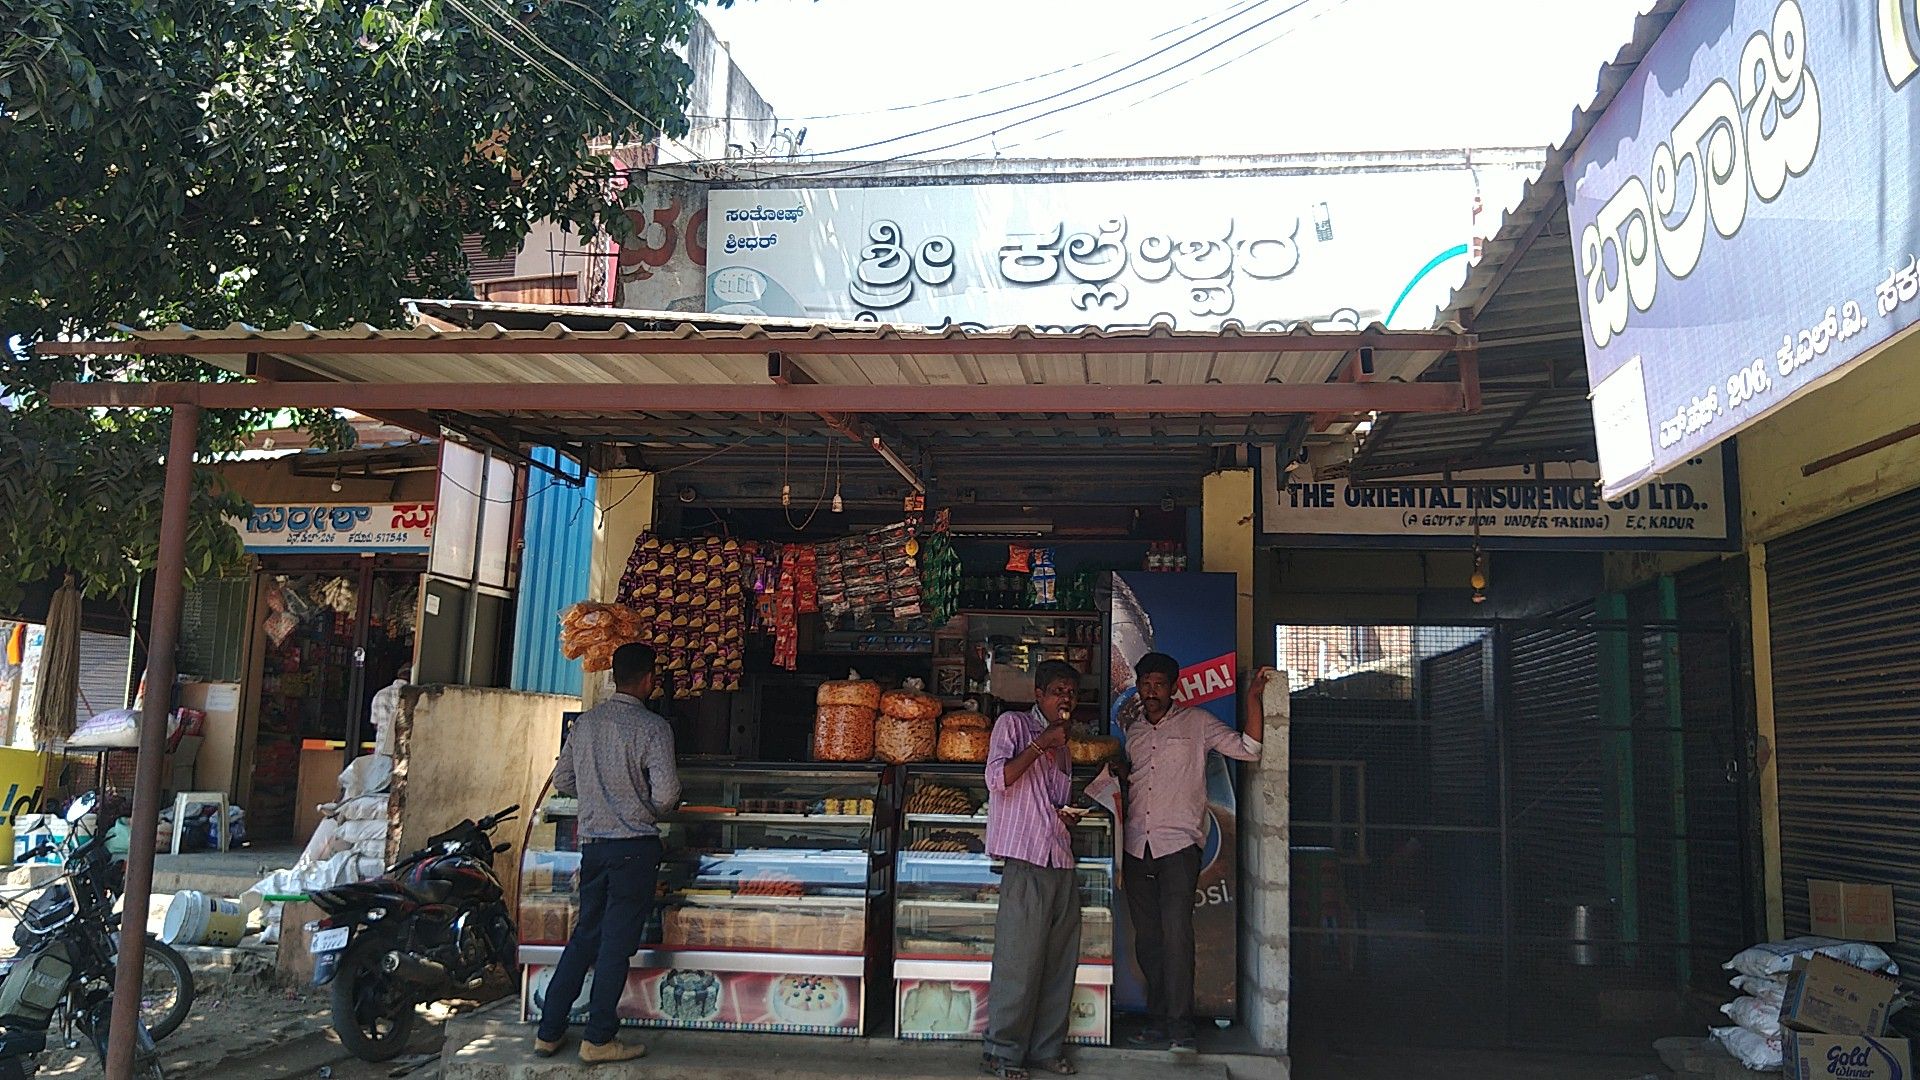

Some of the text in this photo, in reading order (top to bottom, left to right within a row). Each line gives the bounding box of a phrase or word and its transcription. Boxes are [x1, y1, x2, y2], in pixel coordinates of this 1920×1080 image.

[1581, 0, 1821, 348] ಬಾಲಾಜಿ
[725, 205, 804, 224] ಸಂತೋಷ್
[724, 233, 778, 254] ಶ್ರೀಧರ್
[850, 214, 1300, 316] ಶ್ರೀ ಕಲ್ಲೇಶ್ವರ
[1288, 483, 1335, 508] THE
[1344, 484, 1461, 509] ORIENTAL
[1466, 484, 1599, 510] INSURENCE
[246, 505, 373, 533] ಸುರೇಶ್
